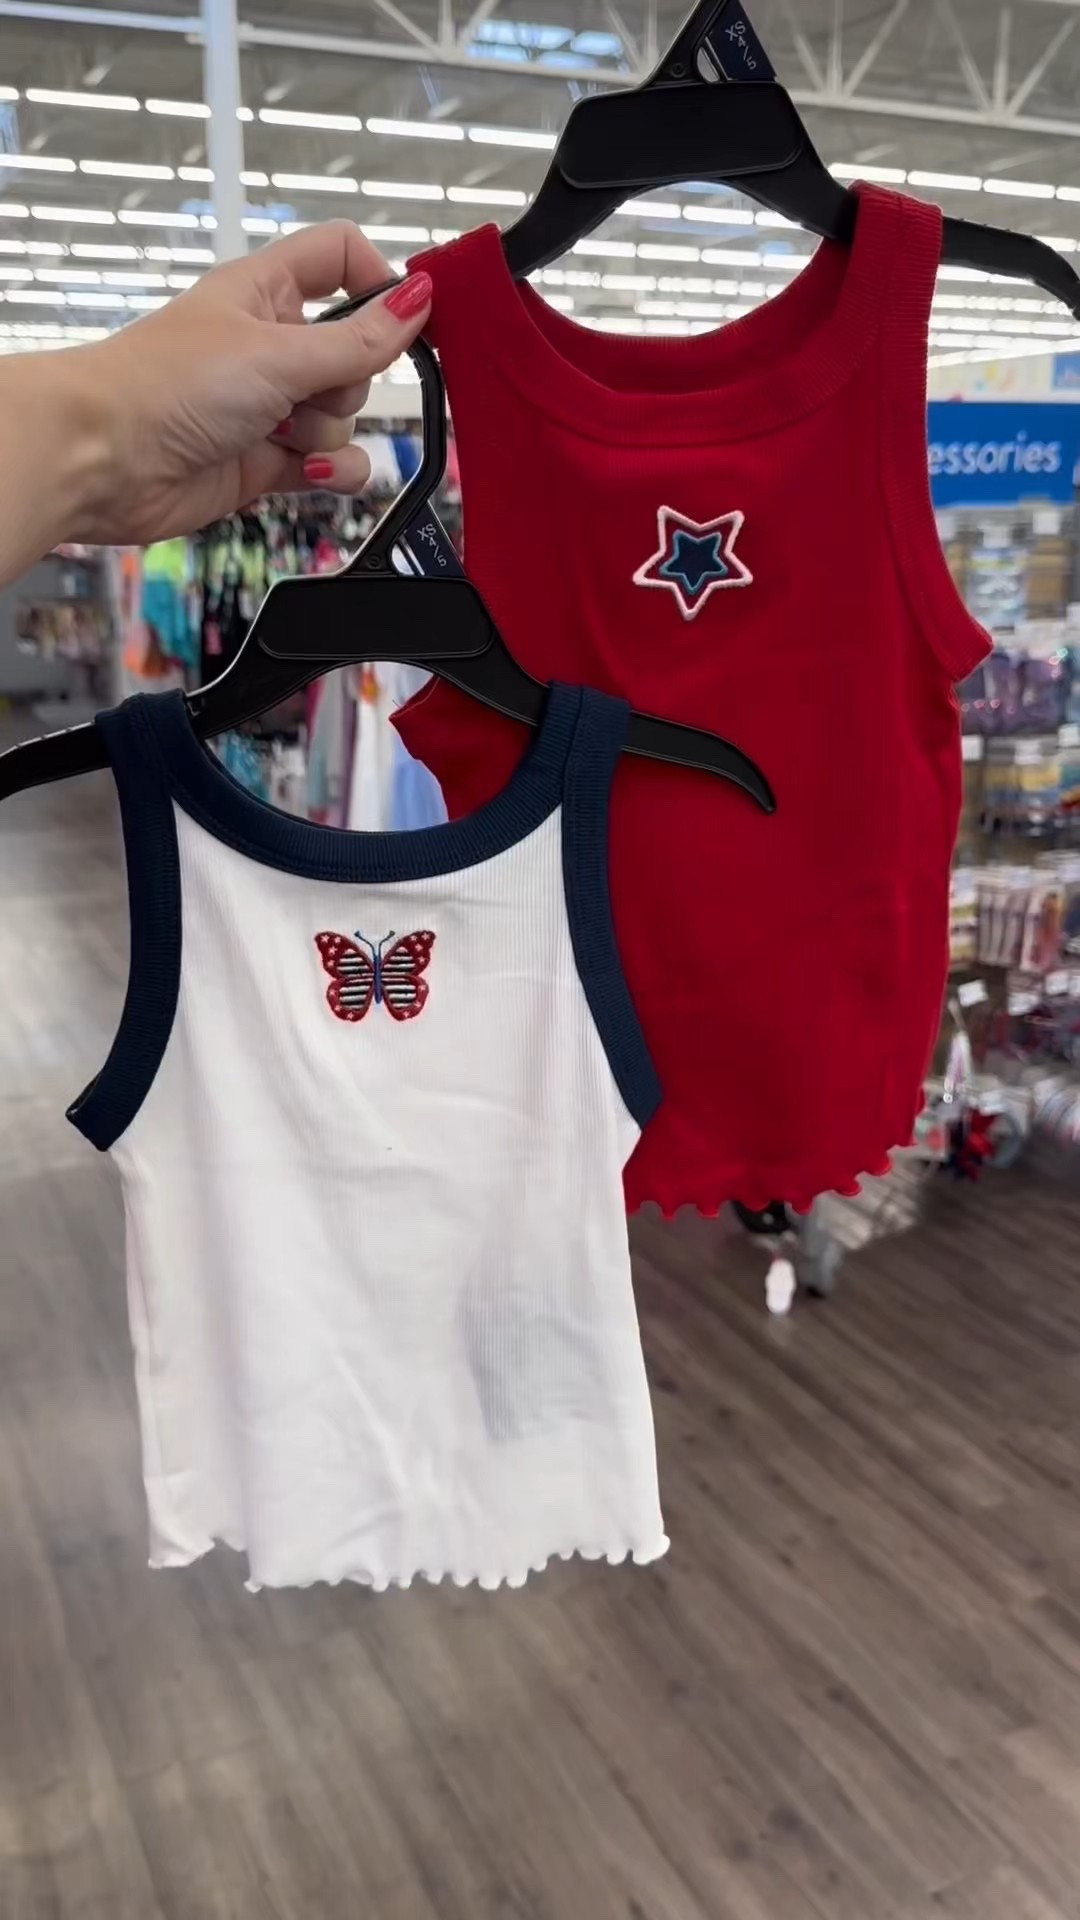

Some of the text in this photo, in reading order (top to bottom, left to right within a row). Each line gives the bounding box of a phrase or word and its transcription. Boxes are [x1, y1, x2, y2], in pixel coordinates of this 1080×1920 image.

[725, 21, 746, 41] XS
[738, 36, 757, 70] 4/5
[417, 523, 437, 541] XS
[429, 537, 447, 567] 4/5
